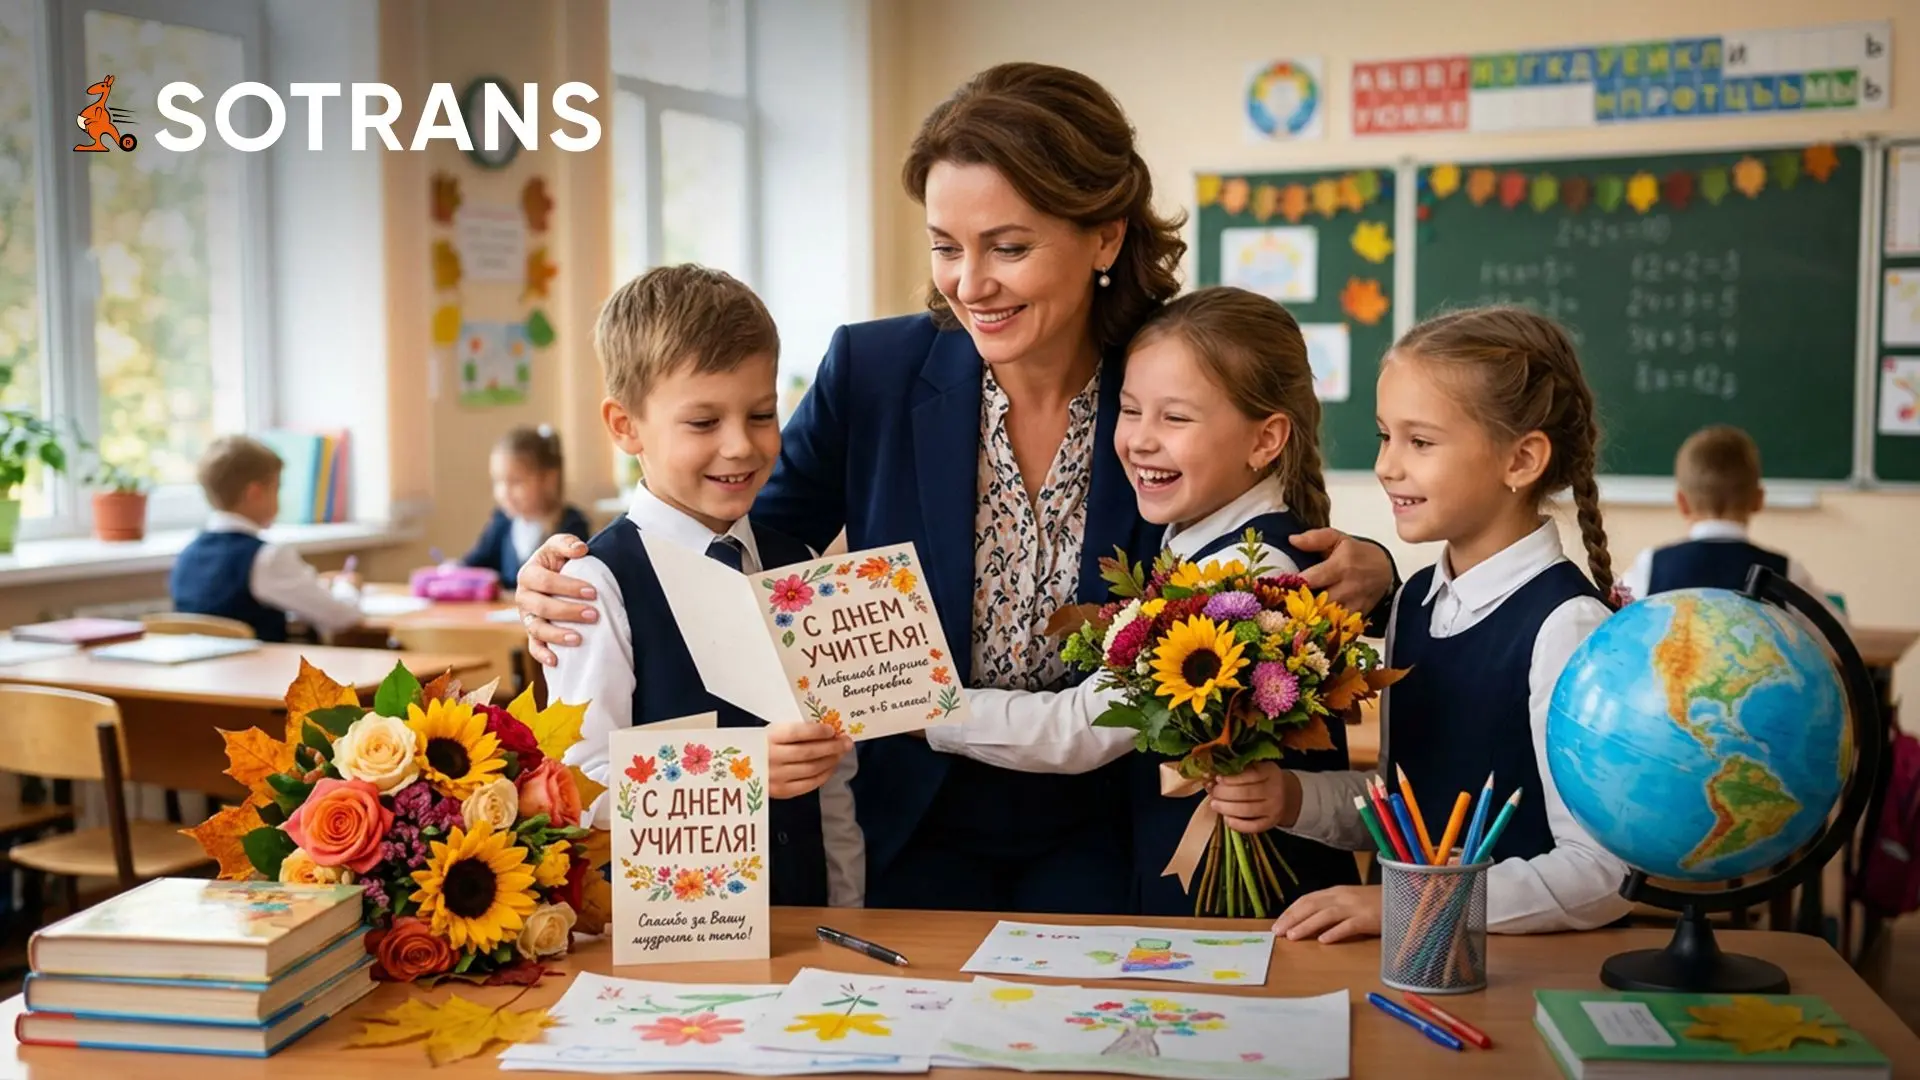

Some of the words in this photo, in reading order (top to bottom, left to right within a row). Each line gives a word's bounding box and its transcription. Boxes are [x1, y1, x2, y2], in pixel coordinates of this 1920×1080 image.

[803, 615, 821, 637] С
[832, 597, 905, 635] ДНЕМ
[801, 622, 929, 668] УЧИТЕЛЯ!
[642, 789, 658, 817] С
[667, 788, 742, 820] ДНЕМ
[630, 823, 756, 856] УЧИТЕЛЯ!
[638, 911, 688, 928] Спасибо
[690, 916, 707, 929] за
[710, 910, 746, 929] Вашу
[697, 934, 705, 942] и
[708, 926, 753, 941] тепло!
